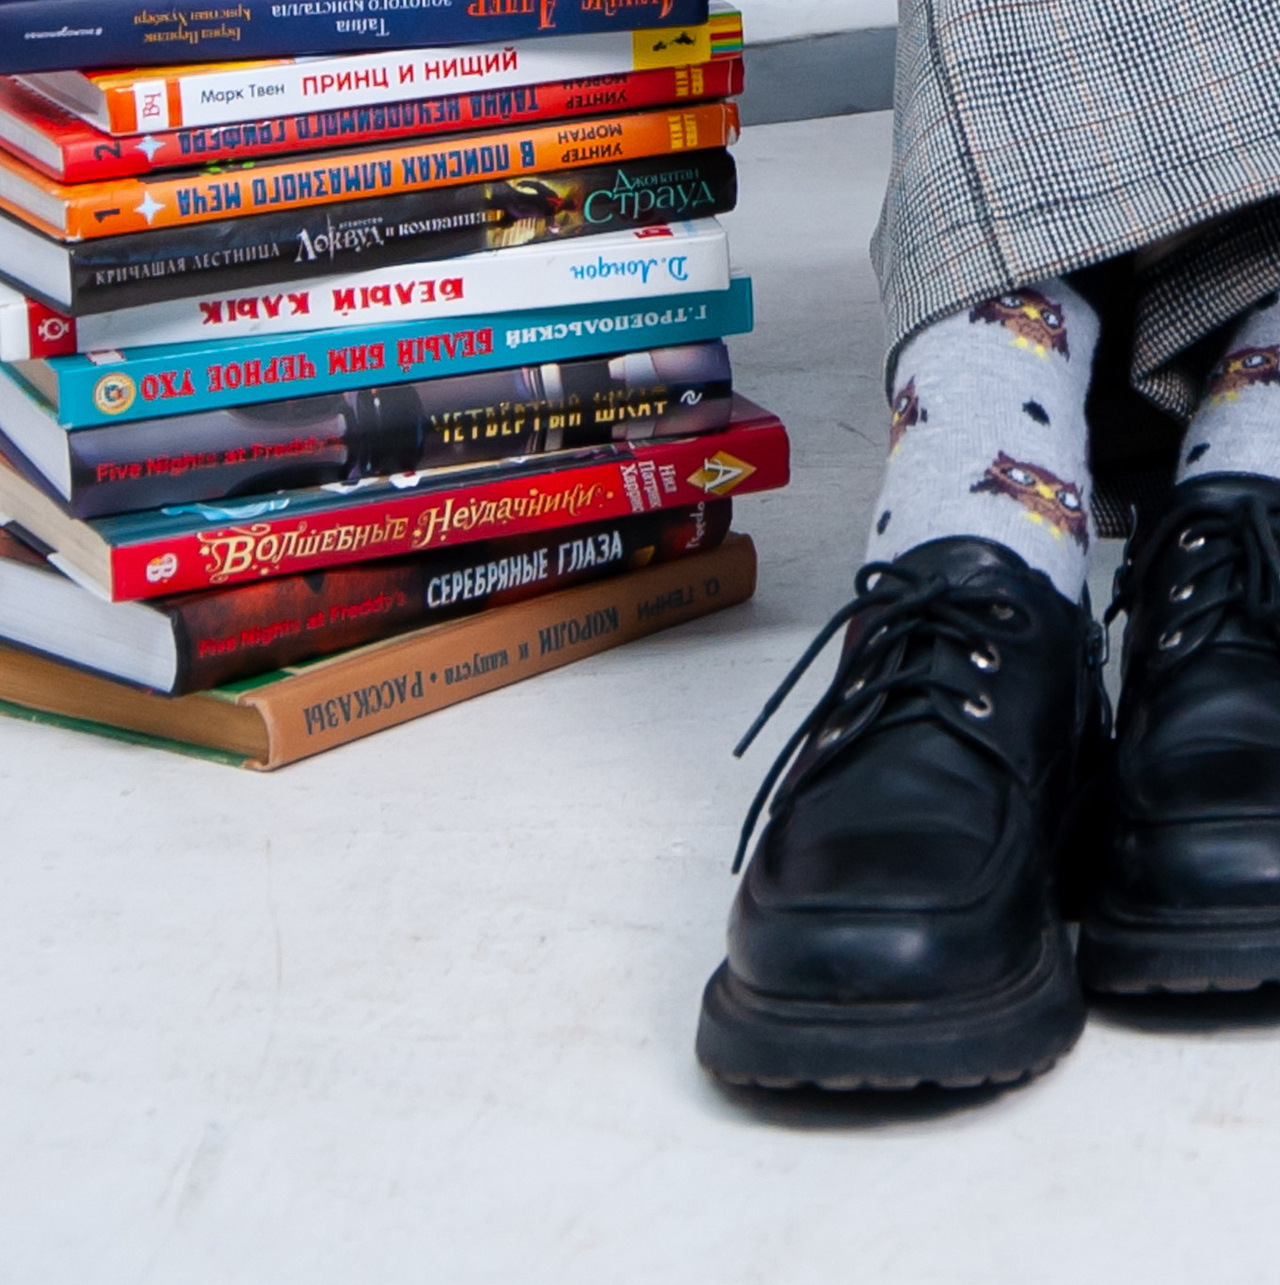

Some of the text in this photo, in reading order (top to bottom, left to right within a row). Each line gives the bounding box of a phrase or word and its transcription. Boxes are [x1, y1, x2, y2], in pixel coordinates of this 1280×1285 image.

[336, 18, 391, 37] Тайна
[301, 47, 519, 96] ПРИНЦ И НИЩИЙ
[200, 82, 285, 105] Марк Твен
[470, 85, 540, 121] ТАЙНА
[565, 90, 628, 111] УИНТЕР
[94, 139, 121, 161] 2
[557, 123, 623, 144] МОРГАН
[561, 141, 623, 163] УИНТЕР
[176, 139, 535, 217] В ПОИСКАХ АЛМАЗНОГО МЕЧА
[584, 181, 715, 224] Страуд
[192, 242, 280, 270] ЛЕСТНИЦА
[571, 256, 658, 283] Лондон
[199, 277, 464, 325] БЕЛЫЙ КЛЫК
[506, 307, 686, 348] ТРОЕПОЛЬСКИЙ
[140, 327, 493, 400] БЕЛЫЙ БИМ ЧЕРНОЕ УХО
[97, 461, 142, 482] Five
[225, 448, 245, 463] at
[427, 531, 623, 609] СЕРЕБРЯНЫЕ ГЛАЗА
[198, 637, 237, 659] Five
[307, 612, 325, 630] at
[539, 606, 619, 656] КОРОЛИ
[445, 650, 508, 686] капуста
[303, 671, 423, 735] РАССКАЗЫ
